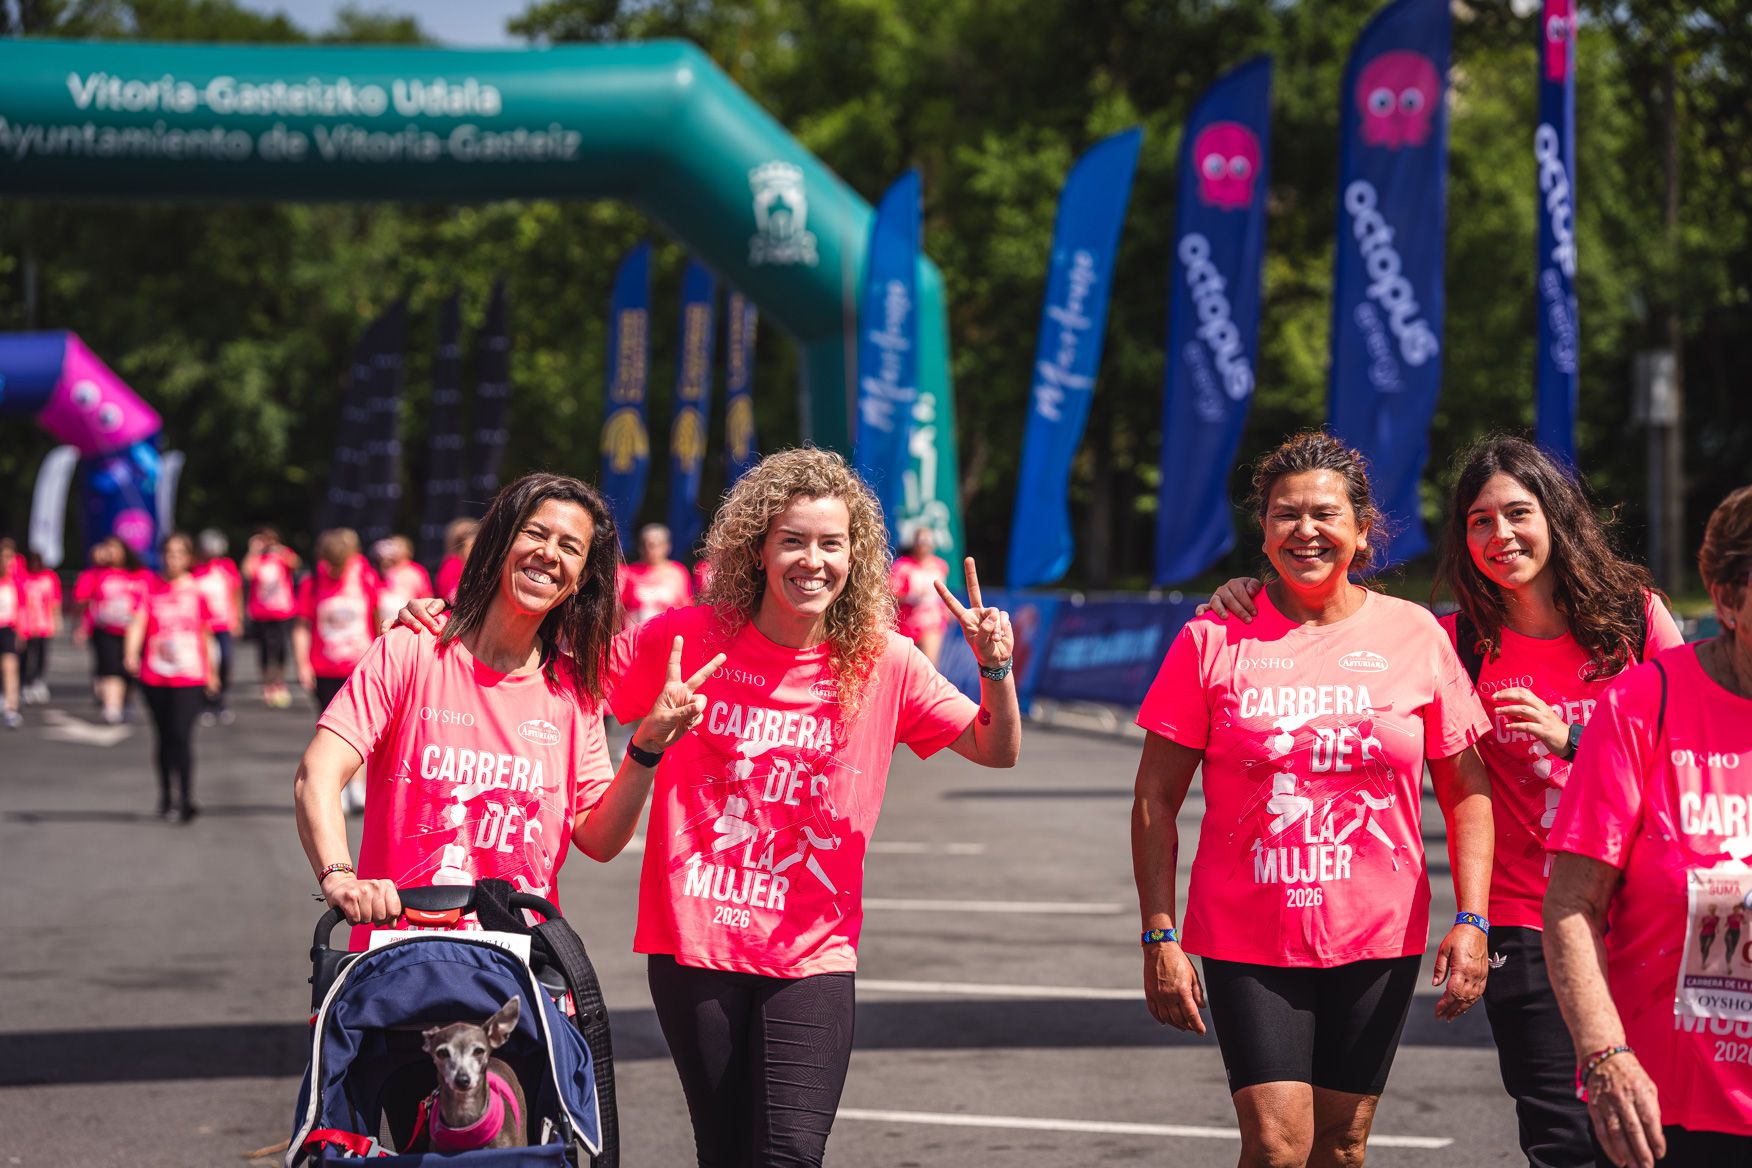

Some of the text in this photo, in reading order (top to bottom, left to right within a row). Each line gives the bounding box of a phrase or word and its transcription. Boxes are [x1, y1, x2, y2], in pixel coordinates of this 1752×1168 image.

[67, 71, 502, 117] Vitoria-Gasteizko Udala
[258, 122, 309, 161] de
[313, 122, 581, 161] Vitoria-Gasteiz
[1345, 180, 1438, 366] octopus
[1178, 233, 1255, 400] octopus
[712, 667, 766, 687] OYSHO
[1238, 658, 1294, 670] OYSHO
[1480, 675, 1534, 693] OYSHO
[420, 706, 474, 727] OYSHO
[1239, 685, 1374, 718] CARRERA
[708, 701, 833, 753] CARRERA
[420, 744, 545, 795] CARRERA
[1310, 727, 1357, 773] DE
[1671, 749, 1740, 769] OYHO
[762, 756, 810, 806] DE
[474, 799, 525, 853] DE
[1304, 799, 1335, 844] LA
[1681, 792, 1752, 836] CAR
[742, 828, 776, 872] LA
[1253, 843, 1353, 884] MUJER
[683, 854, 790, 911] MUJER
[1286, 887, 1323, 907] 2026
[713, 905, 750, 928] 2026
[1698, 995, 1752, 1011] OYSHO
